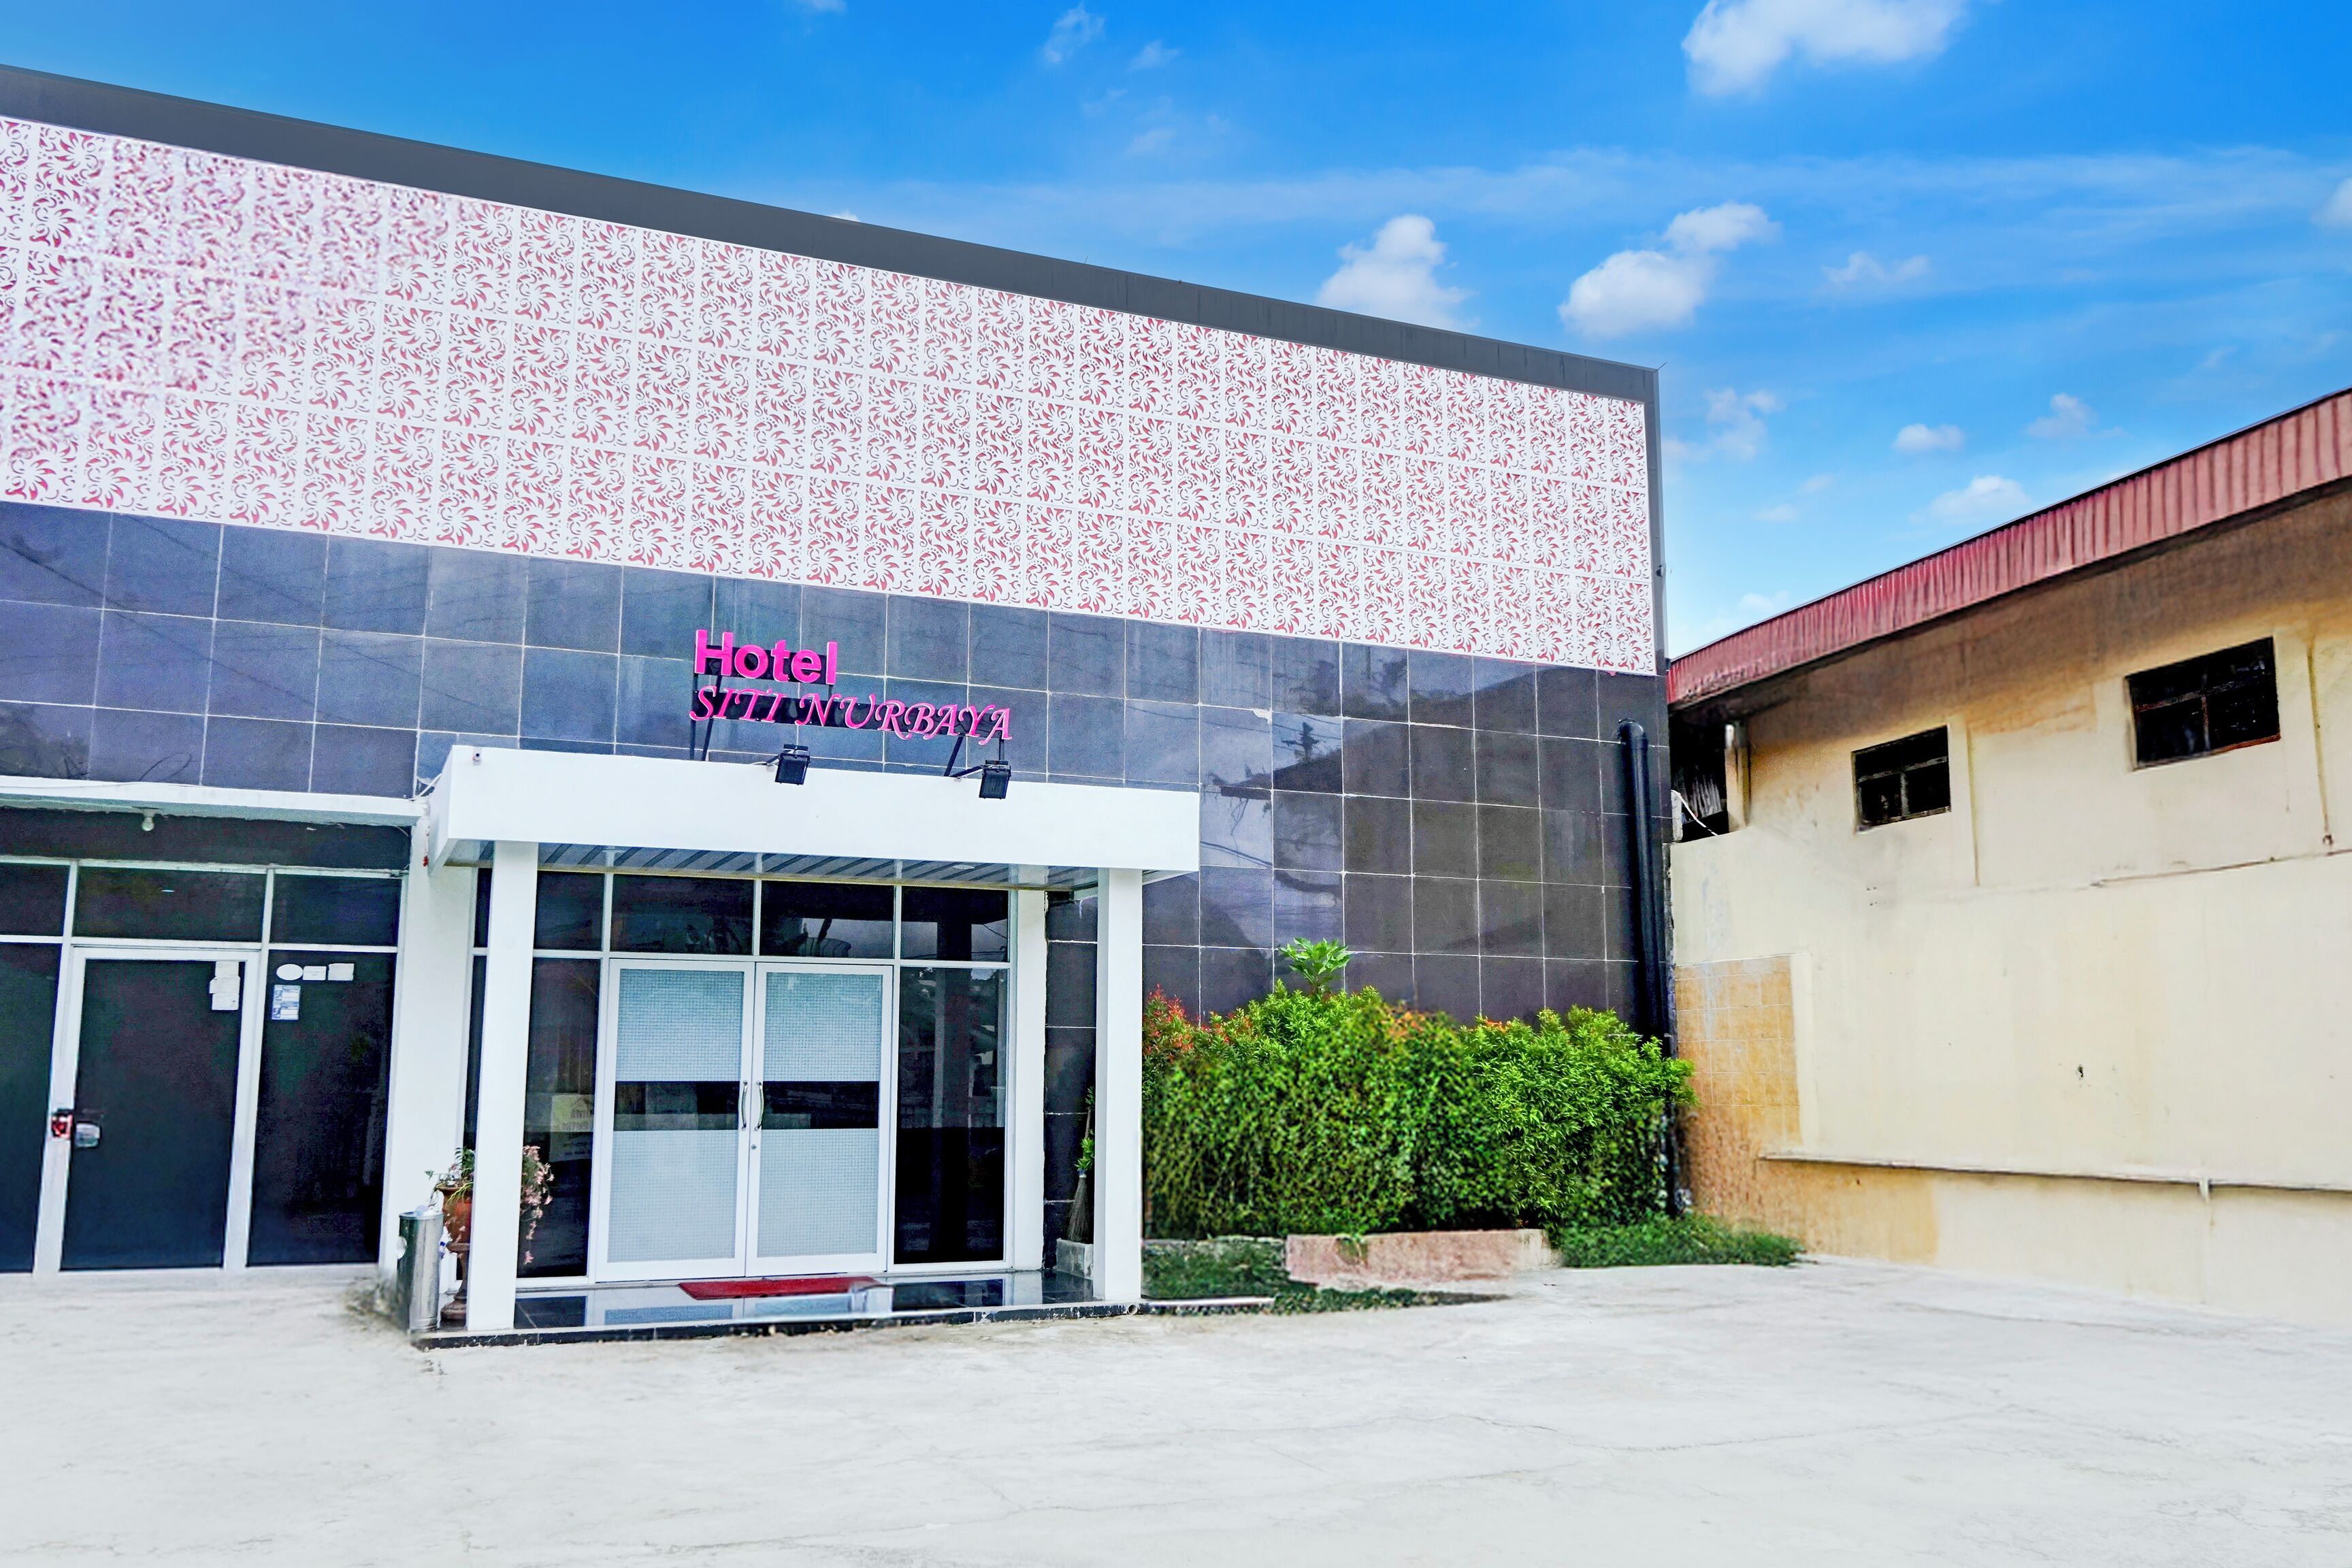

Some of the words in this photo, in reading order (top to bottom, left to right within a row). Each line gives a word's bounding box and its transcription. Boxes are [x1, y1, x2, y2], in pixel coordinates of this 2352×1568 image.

[695, 629, 838, 685] Hotel
[689, 685, 788, 723] SITI
[794, 693, 1013, 745] NURBAYA
